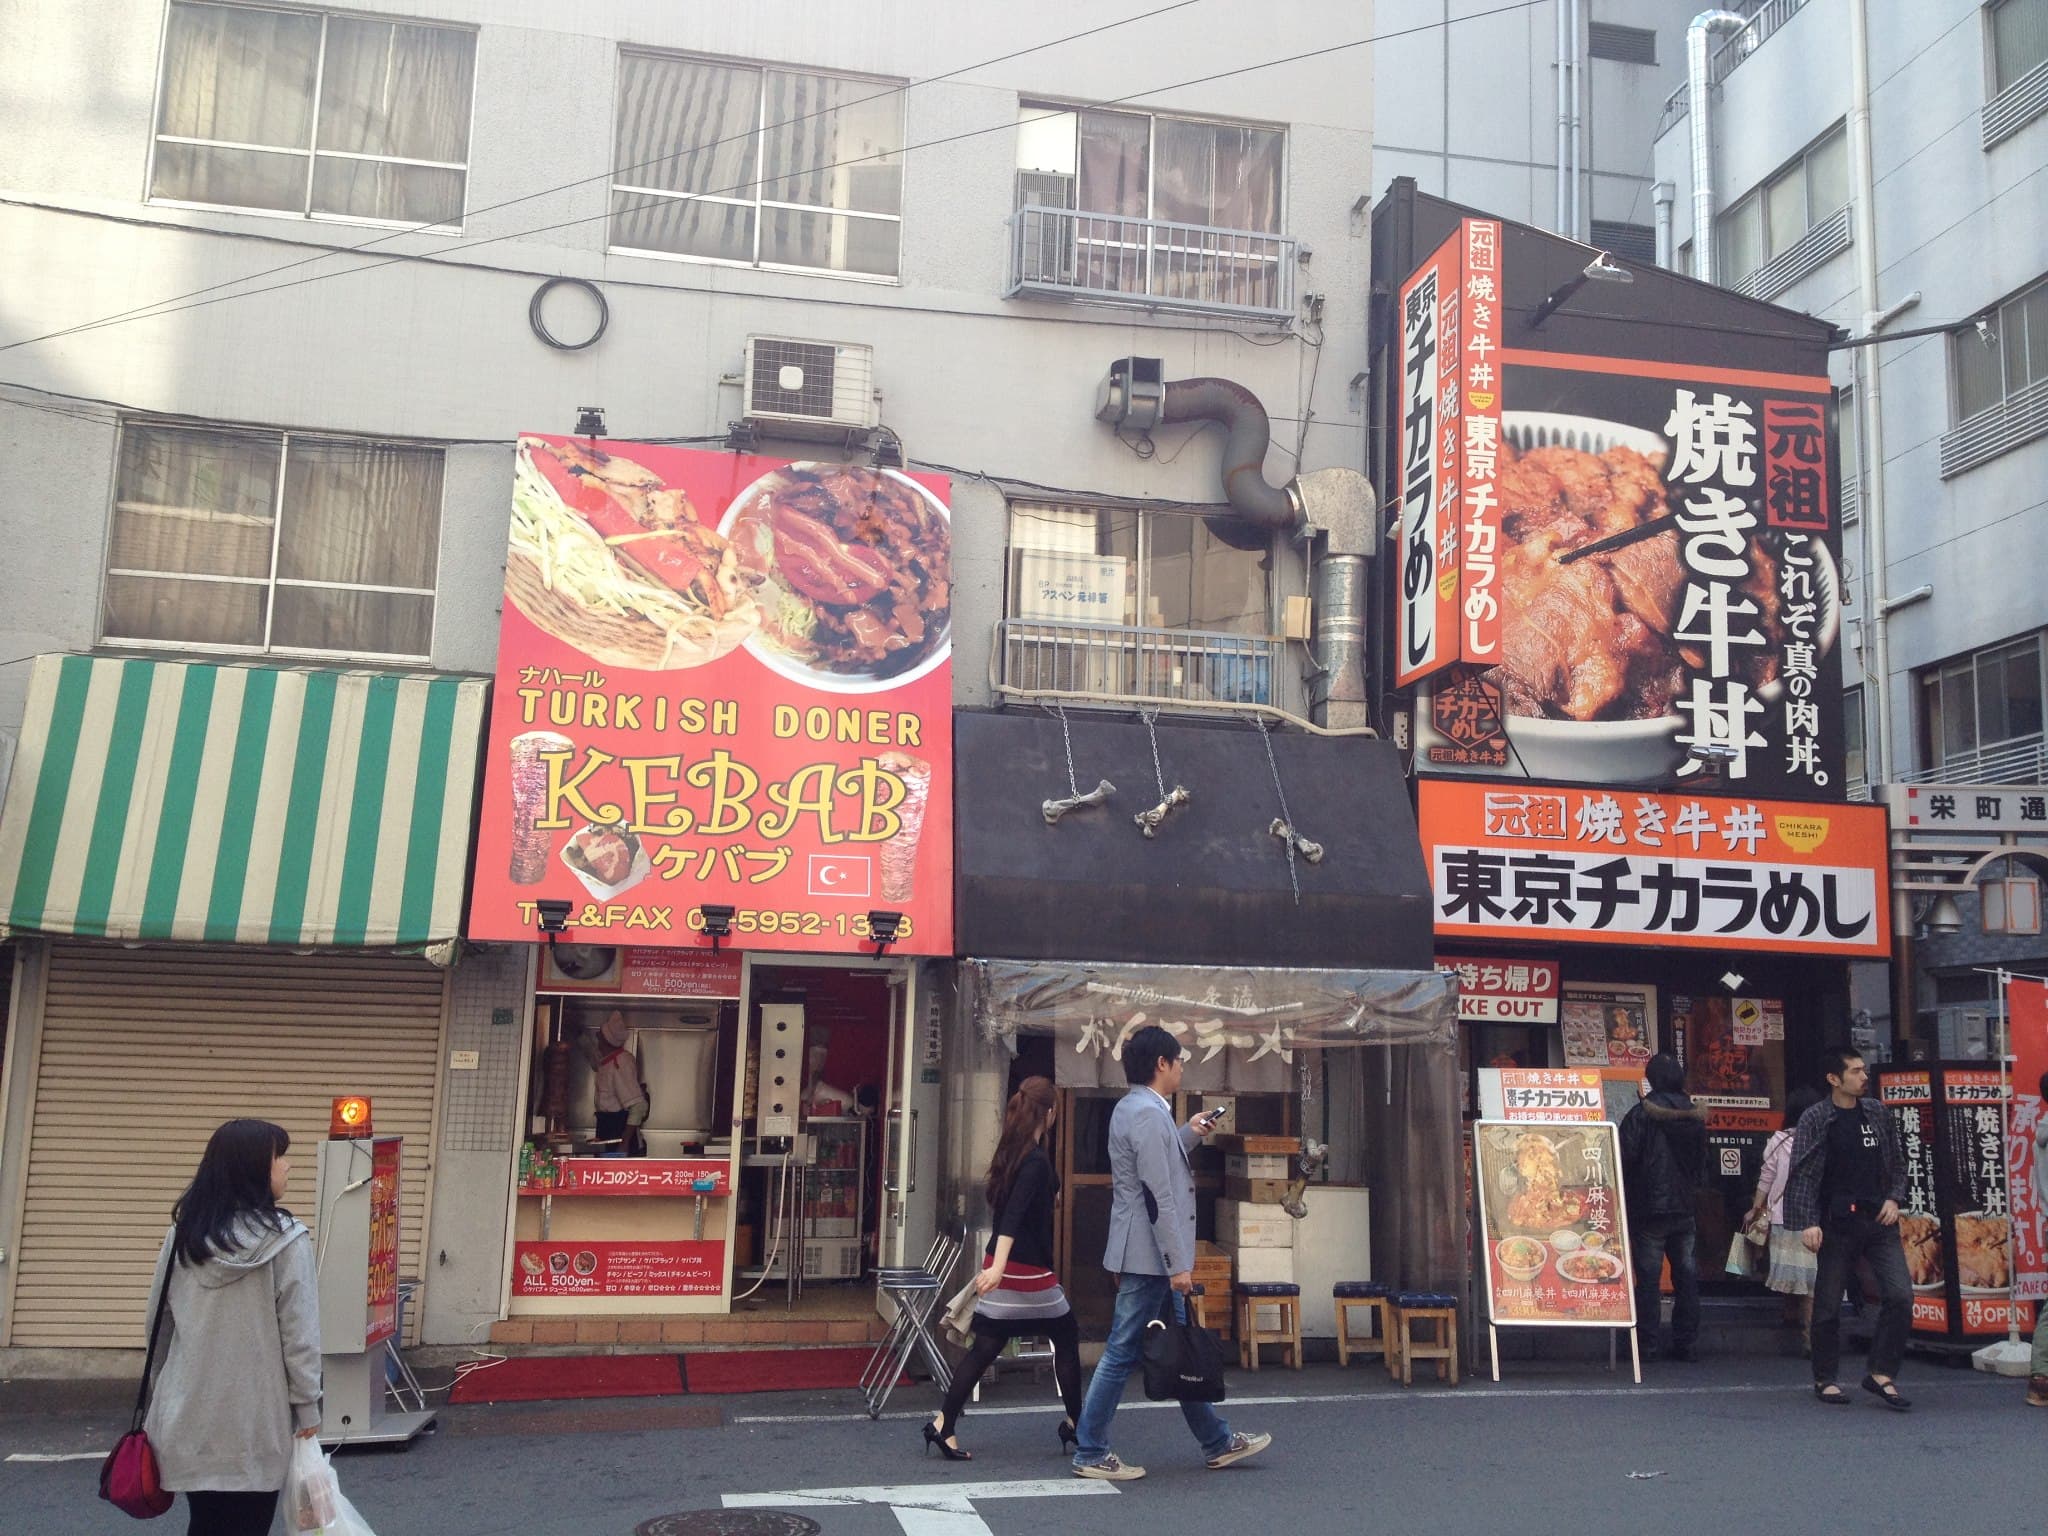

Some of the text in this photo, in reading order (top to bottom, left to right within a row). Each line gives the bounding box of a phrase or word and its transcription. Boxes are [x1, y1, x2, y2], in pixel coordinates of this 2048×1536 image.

[1471, 223, 1492, 269] 元祖
[1467, 275, 1496, 390] 焼き牛丼
[1404, 272, 1437, 666] 東京チカラめし
[1438, 379, 1459, 568] 焼き牛丼
[1768, 405, 1826, 525] 元祖
[1464, 415, 1499, 655] 東京チカラめし
[1664, 388, 1767, 779] 焼き牛丼
[519, 666, 605, 687] ナハール
[1780, 532, 1829, 787] これぞ真の肉丼。
[517, 689, 922, 747] TURKISH DONER
[1437, 695, 1496, 719] チカラ
[1452, 719, 1486, 739] めし
[534, 746, 907, 844] KEBAB
[1930, 795, 2047, 820] 栄町通
[1488, 794, 1767, 854] 元祖 焼き牛丼
[1779, 822, 1822, 831] CHIKARA
[1787, 831, 1818, 839] MESHI
[652, 844, 793, 883] ケバブ
[1441, 850, 1870, 940] 東京チカラめし
[686, 905, 913, 938] 0-5952-133
[664, 979, 698, 988] 500yen
[1497, 1000, 1543, 1017] OUT
[1528, 1072, 1580, 1085] 焼き牛丼
[583, 1170, 672, 1185] トルコのジュース
[1902, 1106, 1926, 1214] 焼き牛丼
[1975, 1106, 2006, 1215] 焼き牛丼
[2008, 1095, 2041, 1266] 承ります。
[1582, 1147, 1610, 1230] 四川麻婆
[523, 1275, 594, 1287] ALL 500yen
[1912, 1304, 1945, 1320] OPEN
[1966, 1301, 1981, 1315] 24
